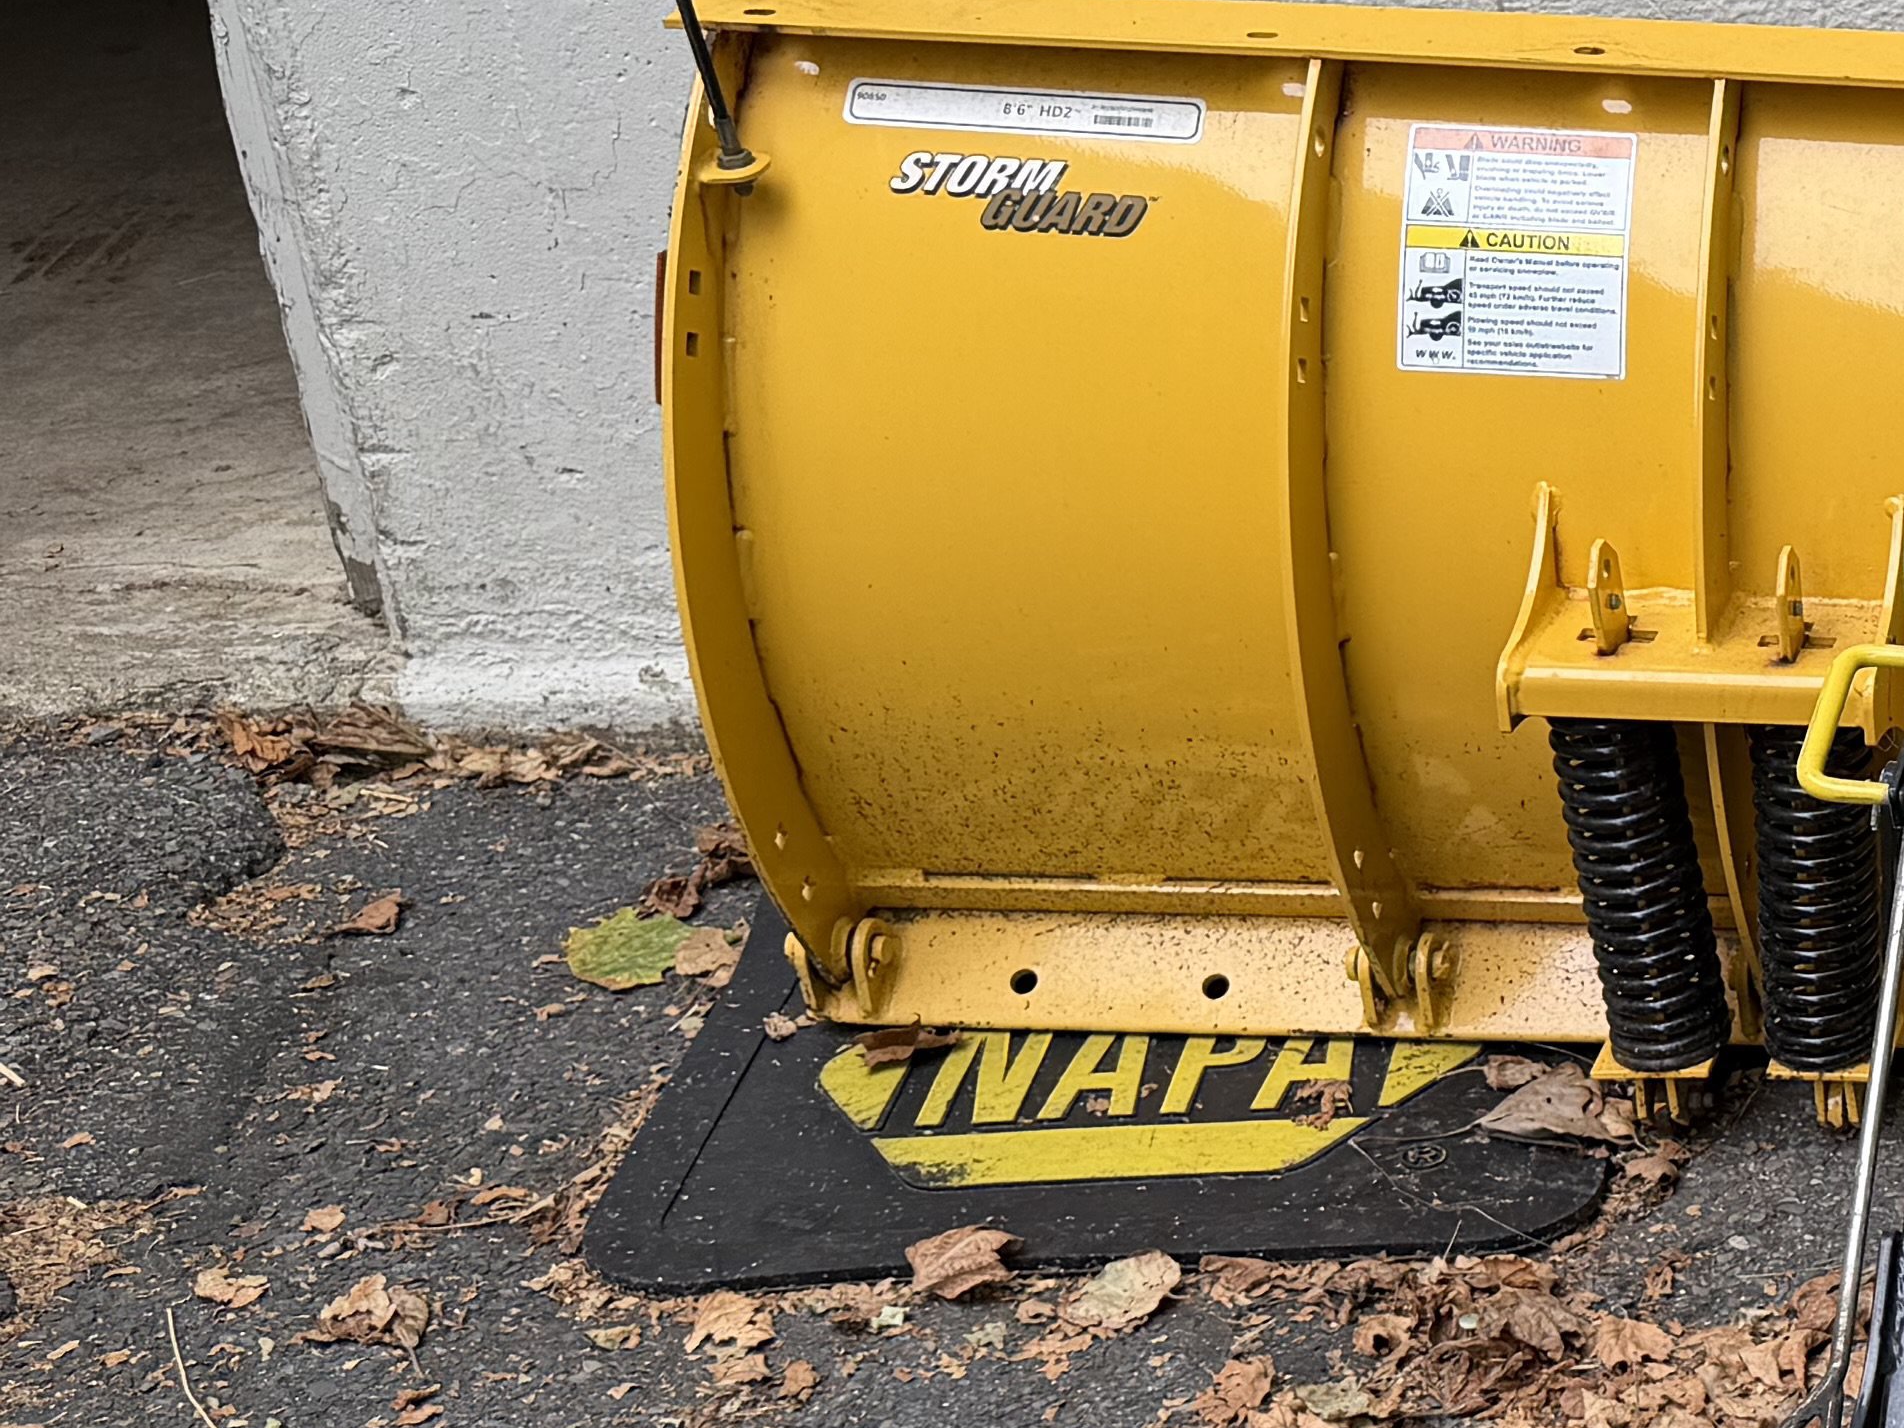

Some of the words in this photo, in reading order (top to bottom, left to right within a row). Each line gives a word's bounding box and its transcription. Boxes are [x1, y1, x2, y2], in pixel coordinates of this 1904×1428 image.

[1490, 134, 1582, 153] WARNING
[889, 150, 1068, 197] STORM
[981, 188, 1148, 238] GUARD
[1486, 232, 1570, 251] CAUTION
[915, 1032, 1354, 1128] NAPA
